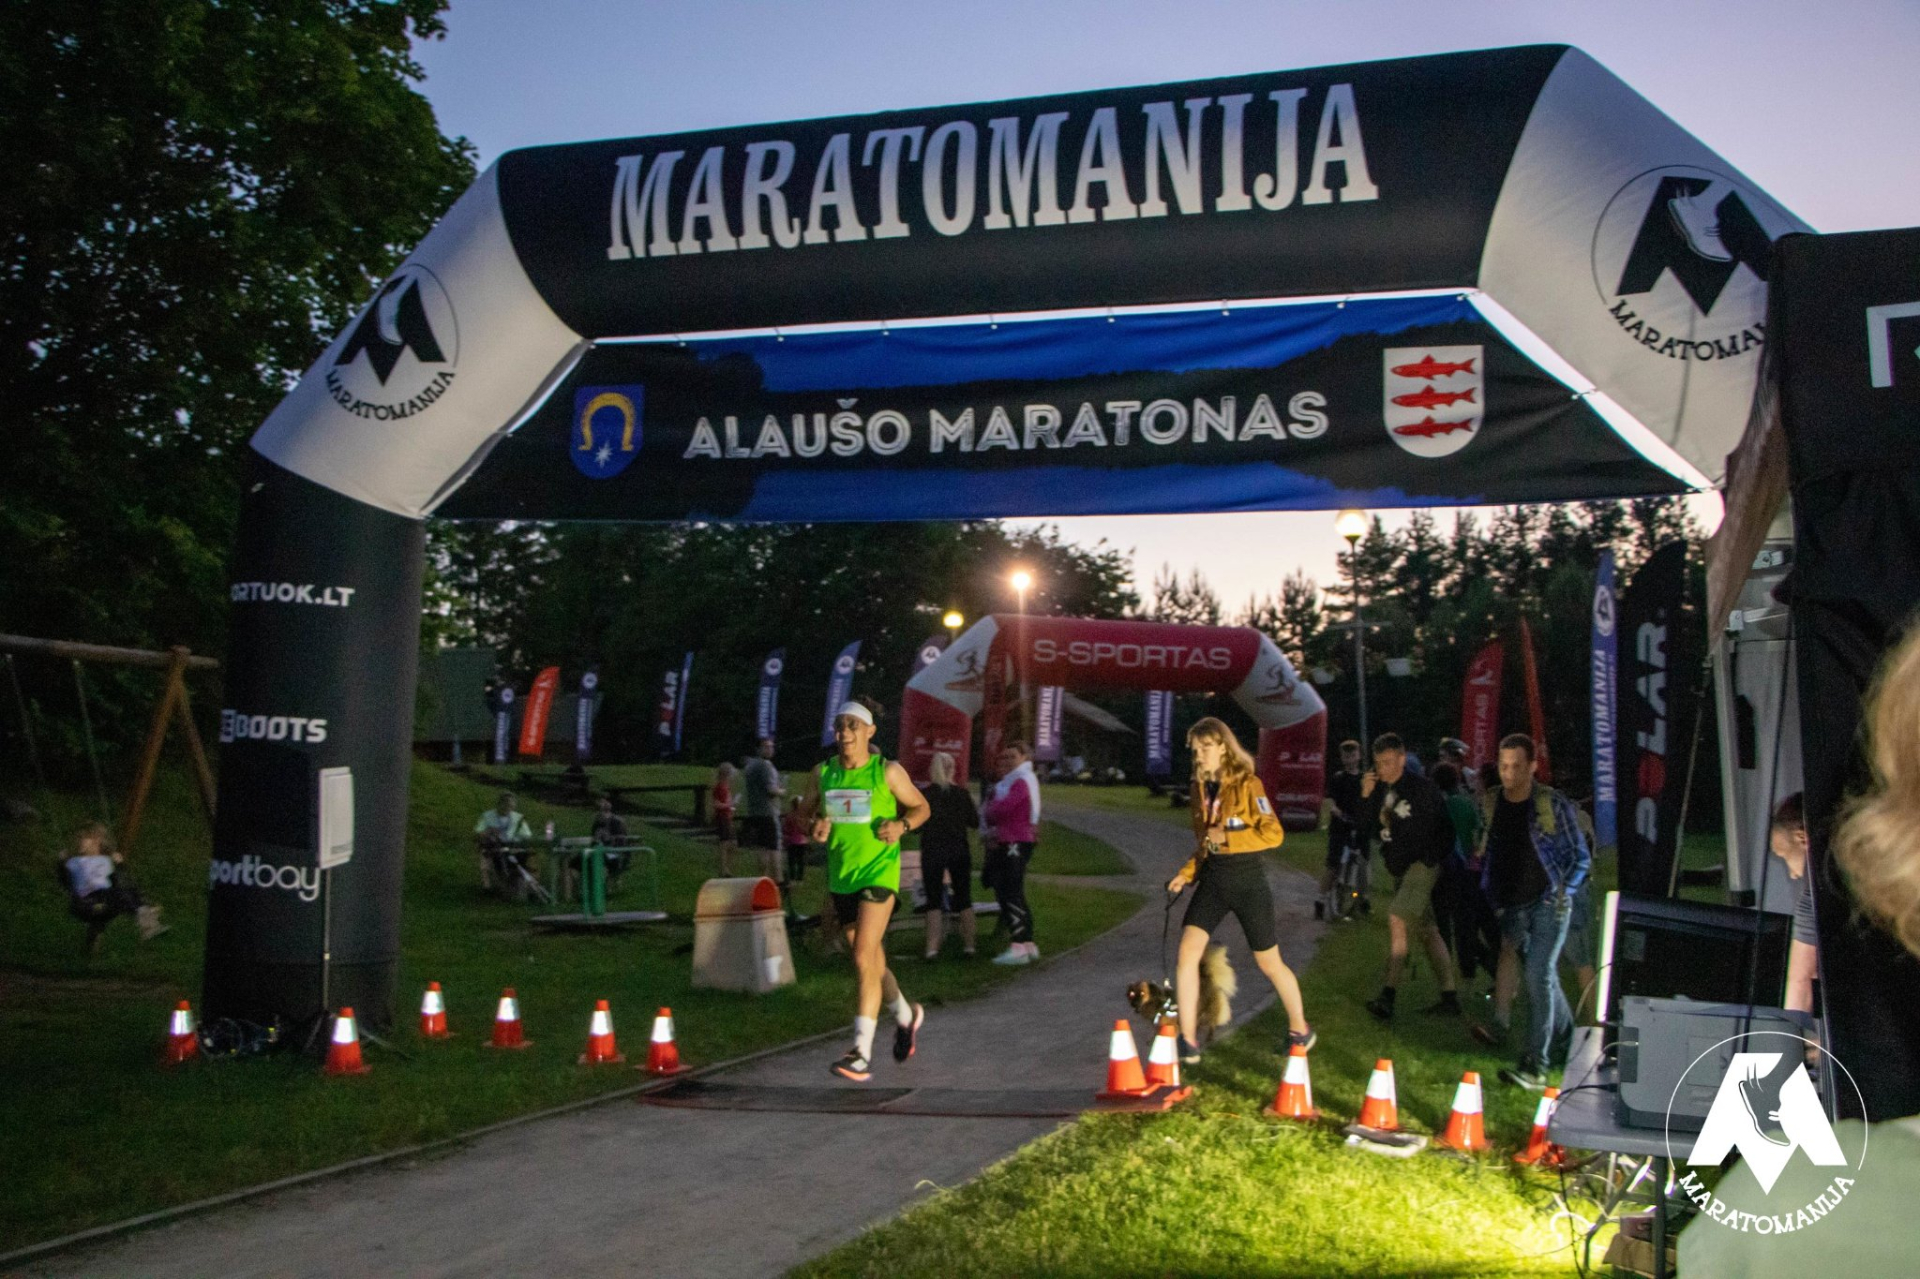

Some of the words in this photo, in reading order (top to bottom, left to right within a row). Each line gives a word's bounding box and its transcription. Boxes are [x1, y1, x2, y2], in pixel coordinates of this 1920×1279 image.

[607, 83, 1379, 261] MARATOMANIJA
[325, 366, 456, 421] MARATOMANIJA
[683, 397, 912, 459] ALAUŠO
[929, 391, 1330, 453] MARATONAS
[1034, 639, 1232, 670] S-SPORTAS
[1592, 649, 1616, 802] MARATOMANIJA
[843, 799, 852, 814] 1
